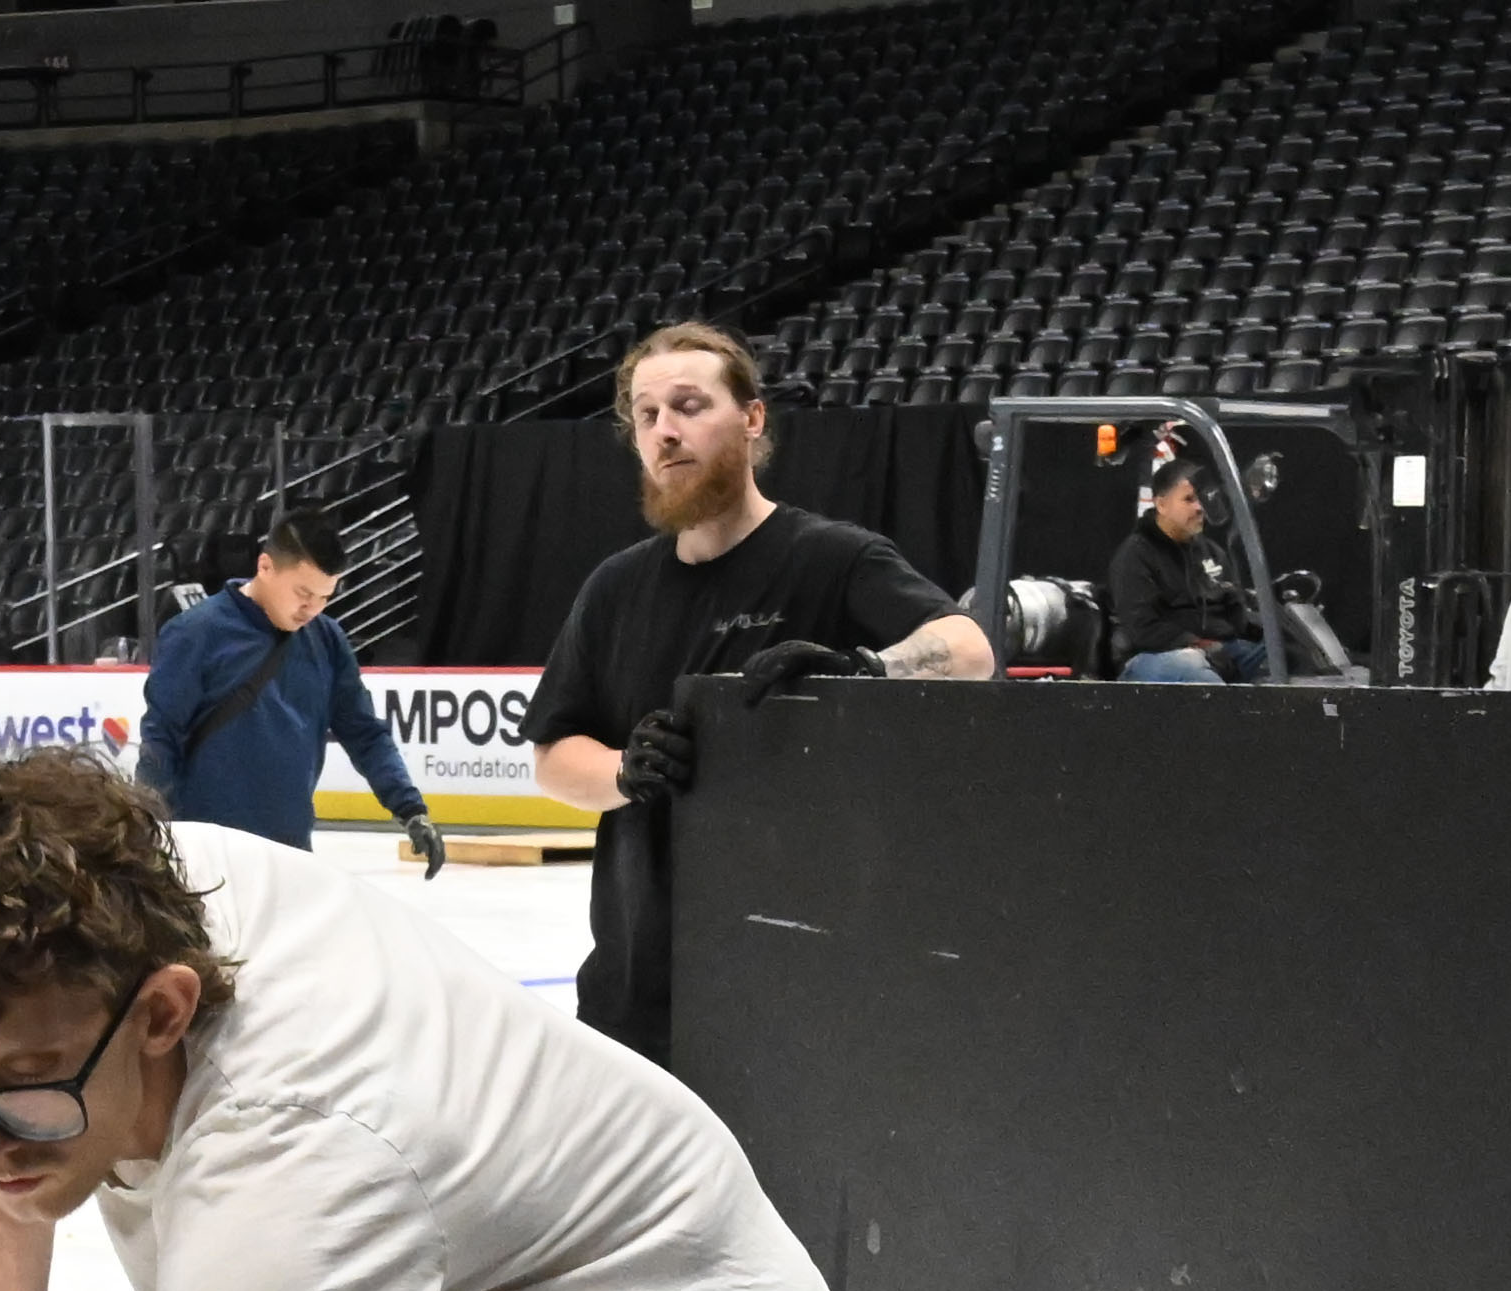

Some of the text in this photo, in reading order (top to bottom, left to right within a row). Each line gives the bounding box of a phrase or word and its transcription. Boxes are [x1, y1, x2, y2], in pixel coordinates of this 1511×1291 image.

[1398, 578, 1415, 678] TOYOTA
[385, 689, 530, 747] MPOS
[424, 755, 531, 779] Foundation
